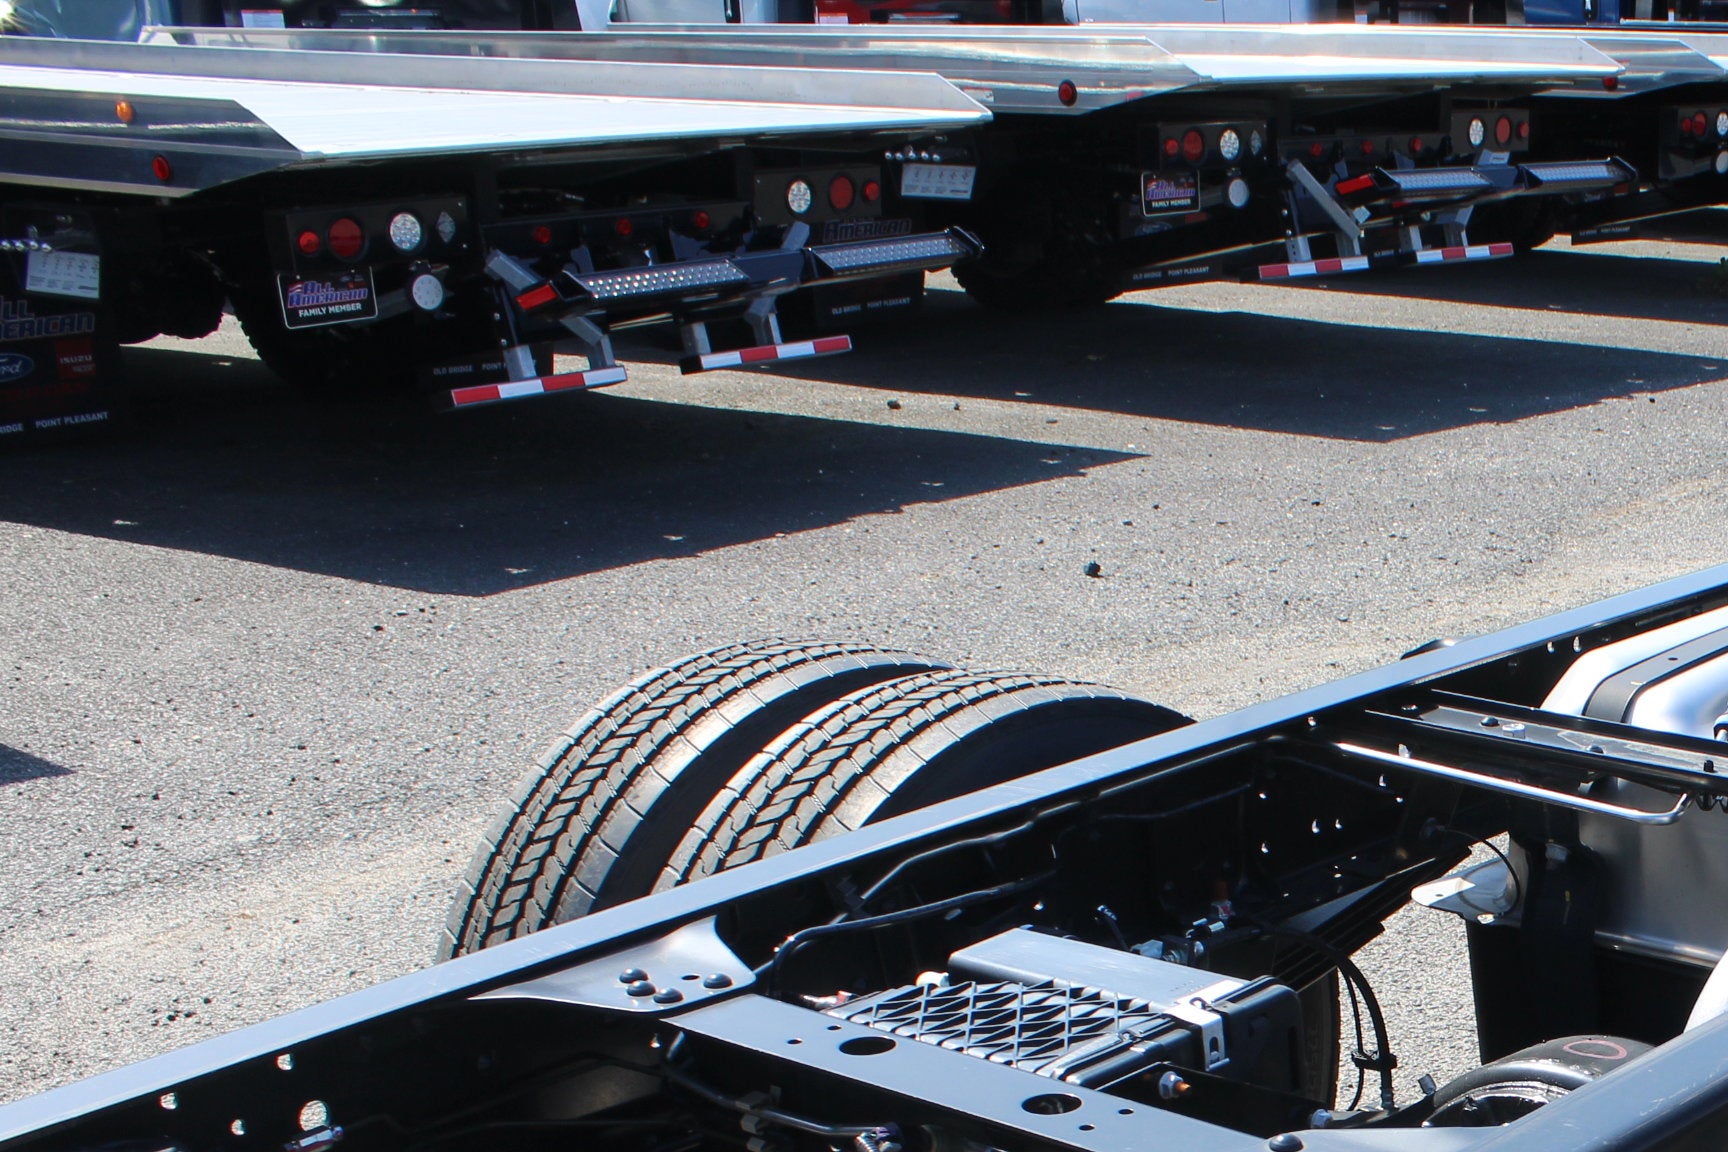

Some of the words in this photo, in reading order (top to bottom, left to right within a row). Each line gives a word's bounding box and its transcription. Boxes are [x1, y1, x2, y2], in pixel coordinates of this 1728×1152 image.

[0, 296, 35, 322] LL
[298, 306, 327, 319] FAMILY
[328, 302, 363, 315] MEMBER
[59, 353, 93, 366] ISUZU
[35, 417, 62, 430] POINT
[63, 411, 110, 426] PLEASANT
